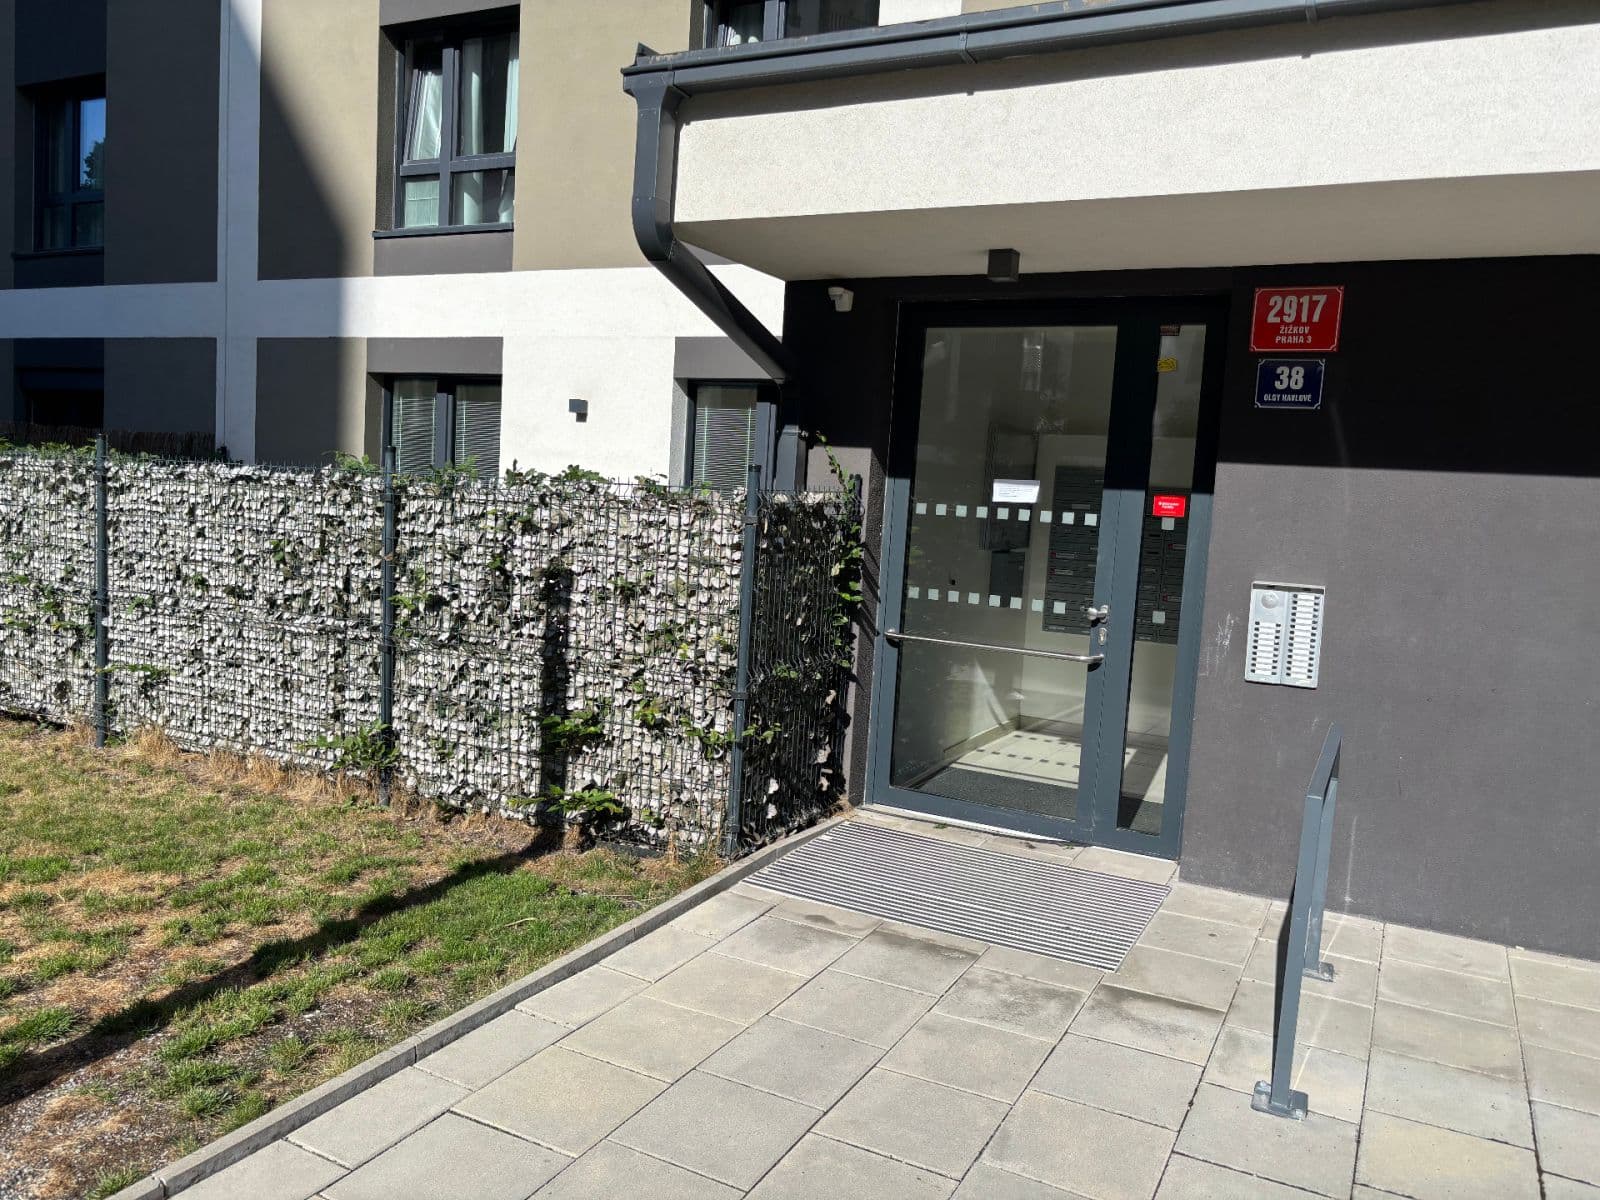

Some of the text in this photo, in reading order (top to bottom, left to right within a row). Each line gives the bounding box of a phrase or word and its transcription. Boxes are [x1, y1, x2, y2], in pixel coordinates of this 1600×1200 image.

[1266, 295, 1328, 323] 2917
[1279, 325, 1310, 334] ŽIŽKOV
[1275, 335, 1312, 344] PRAHA 3
[1274, 366, 1304, 390] 38
